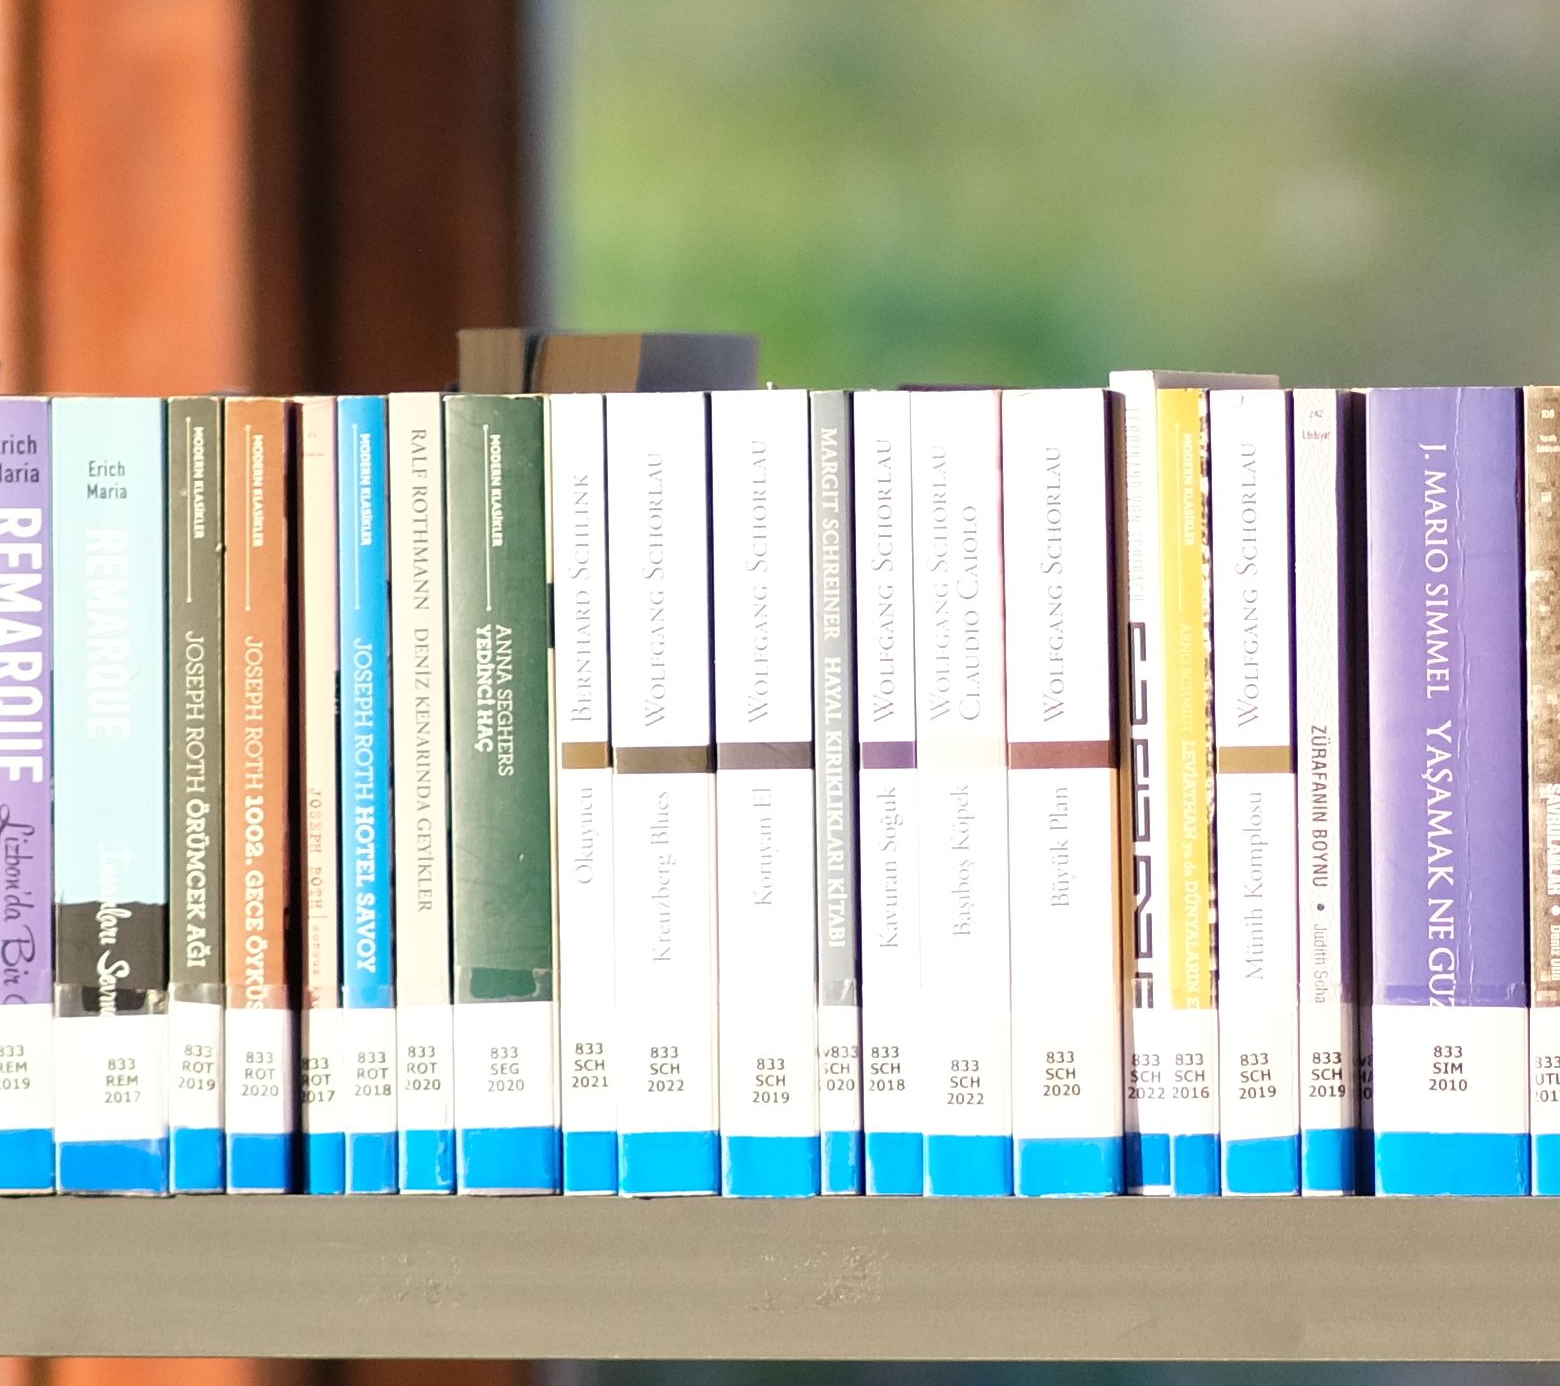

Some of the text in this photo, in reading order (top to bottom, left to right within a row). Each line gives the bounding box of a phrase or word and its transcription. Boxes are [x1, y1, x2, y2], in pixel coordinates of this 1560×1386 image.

[411, 428, 435, 912] RALF ROTHMANN DENİZ KENARINDA GEYİKLER
[473, 625, 494, 753] YEDİNCİ HAÇ
[819, 428, 848, 948] MARGIT SCHREINER HAYAL KIRIKLIKLARI KİTABI
[1417, 442, 1455, 941] J. MARIO SIMMEL YAŞAMAK NE
[496, 625, 515, 777] ANNA SEGHERS
[1433, 1046, 1463, 1059] 833
[757, 1057, 786, 1071] 833
[1432, 1062, 1464, 1076] SIM
[755, 1074, 787, 1088] SCH
[1428, 1079, 1468, 1093] 2010
[752, 1091, 790, 1104] 2019
